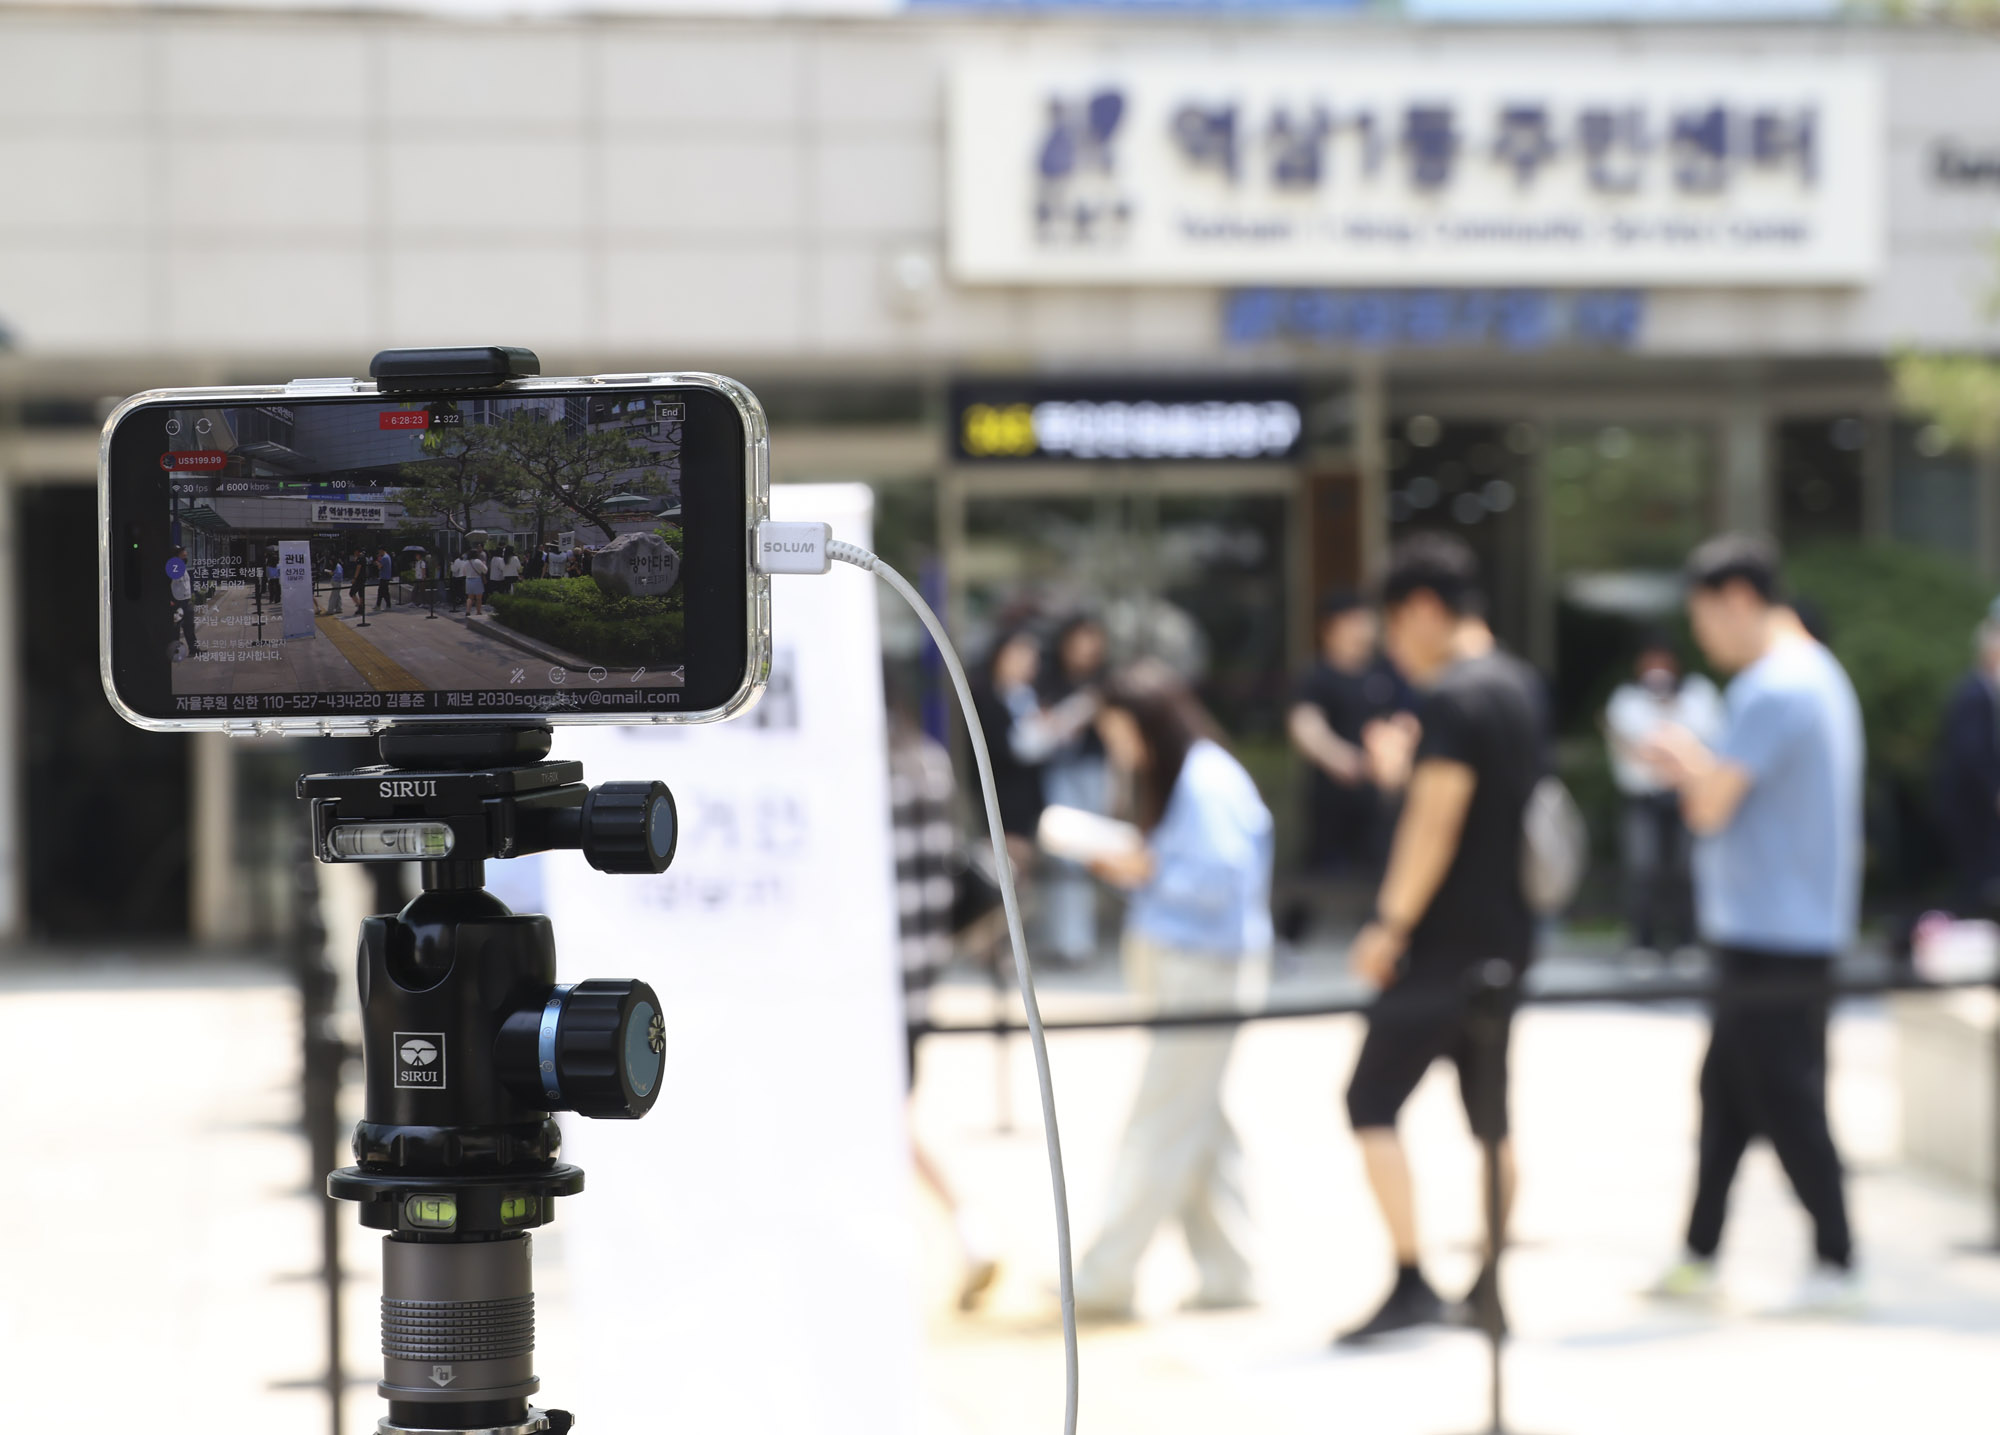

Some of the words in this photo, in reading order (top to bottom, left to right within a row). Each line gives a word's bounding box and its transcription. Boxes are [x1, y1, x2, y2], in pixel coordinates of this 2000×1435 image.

[661, 408, 678, 417] End
[391, 416, 423, 425] 6:28:23
[443, 415, 459, 423] 322
[178, 457, 222, 465] US$199.99
[183, 485, 194, 493] 30
[195, 484, 209, 493] fps
[226, 483, 249, 492] 6000
[250, 482, 270, 493] kbps
[763, 542, 815, 553] SOLUM
[285, 554, 305, 564] 관내
[232, 695, 259, 710] 신한
[262, 694, 381, 709] 110-527-434220
[446, 692, 474, 707] 제보
[379, 780, 438, 798] SIRUI
[401, 1070, 438, 1082] SIRUI
